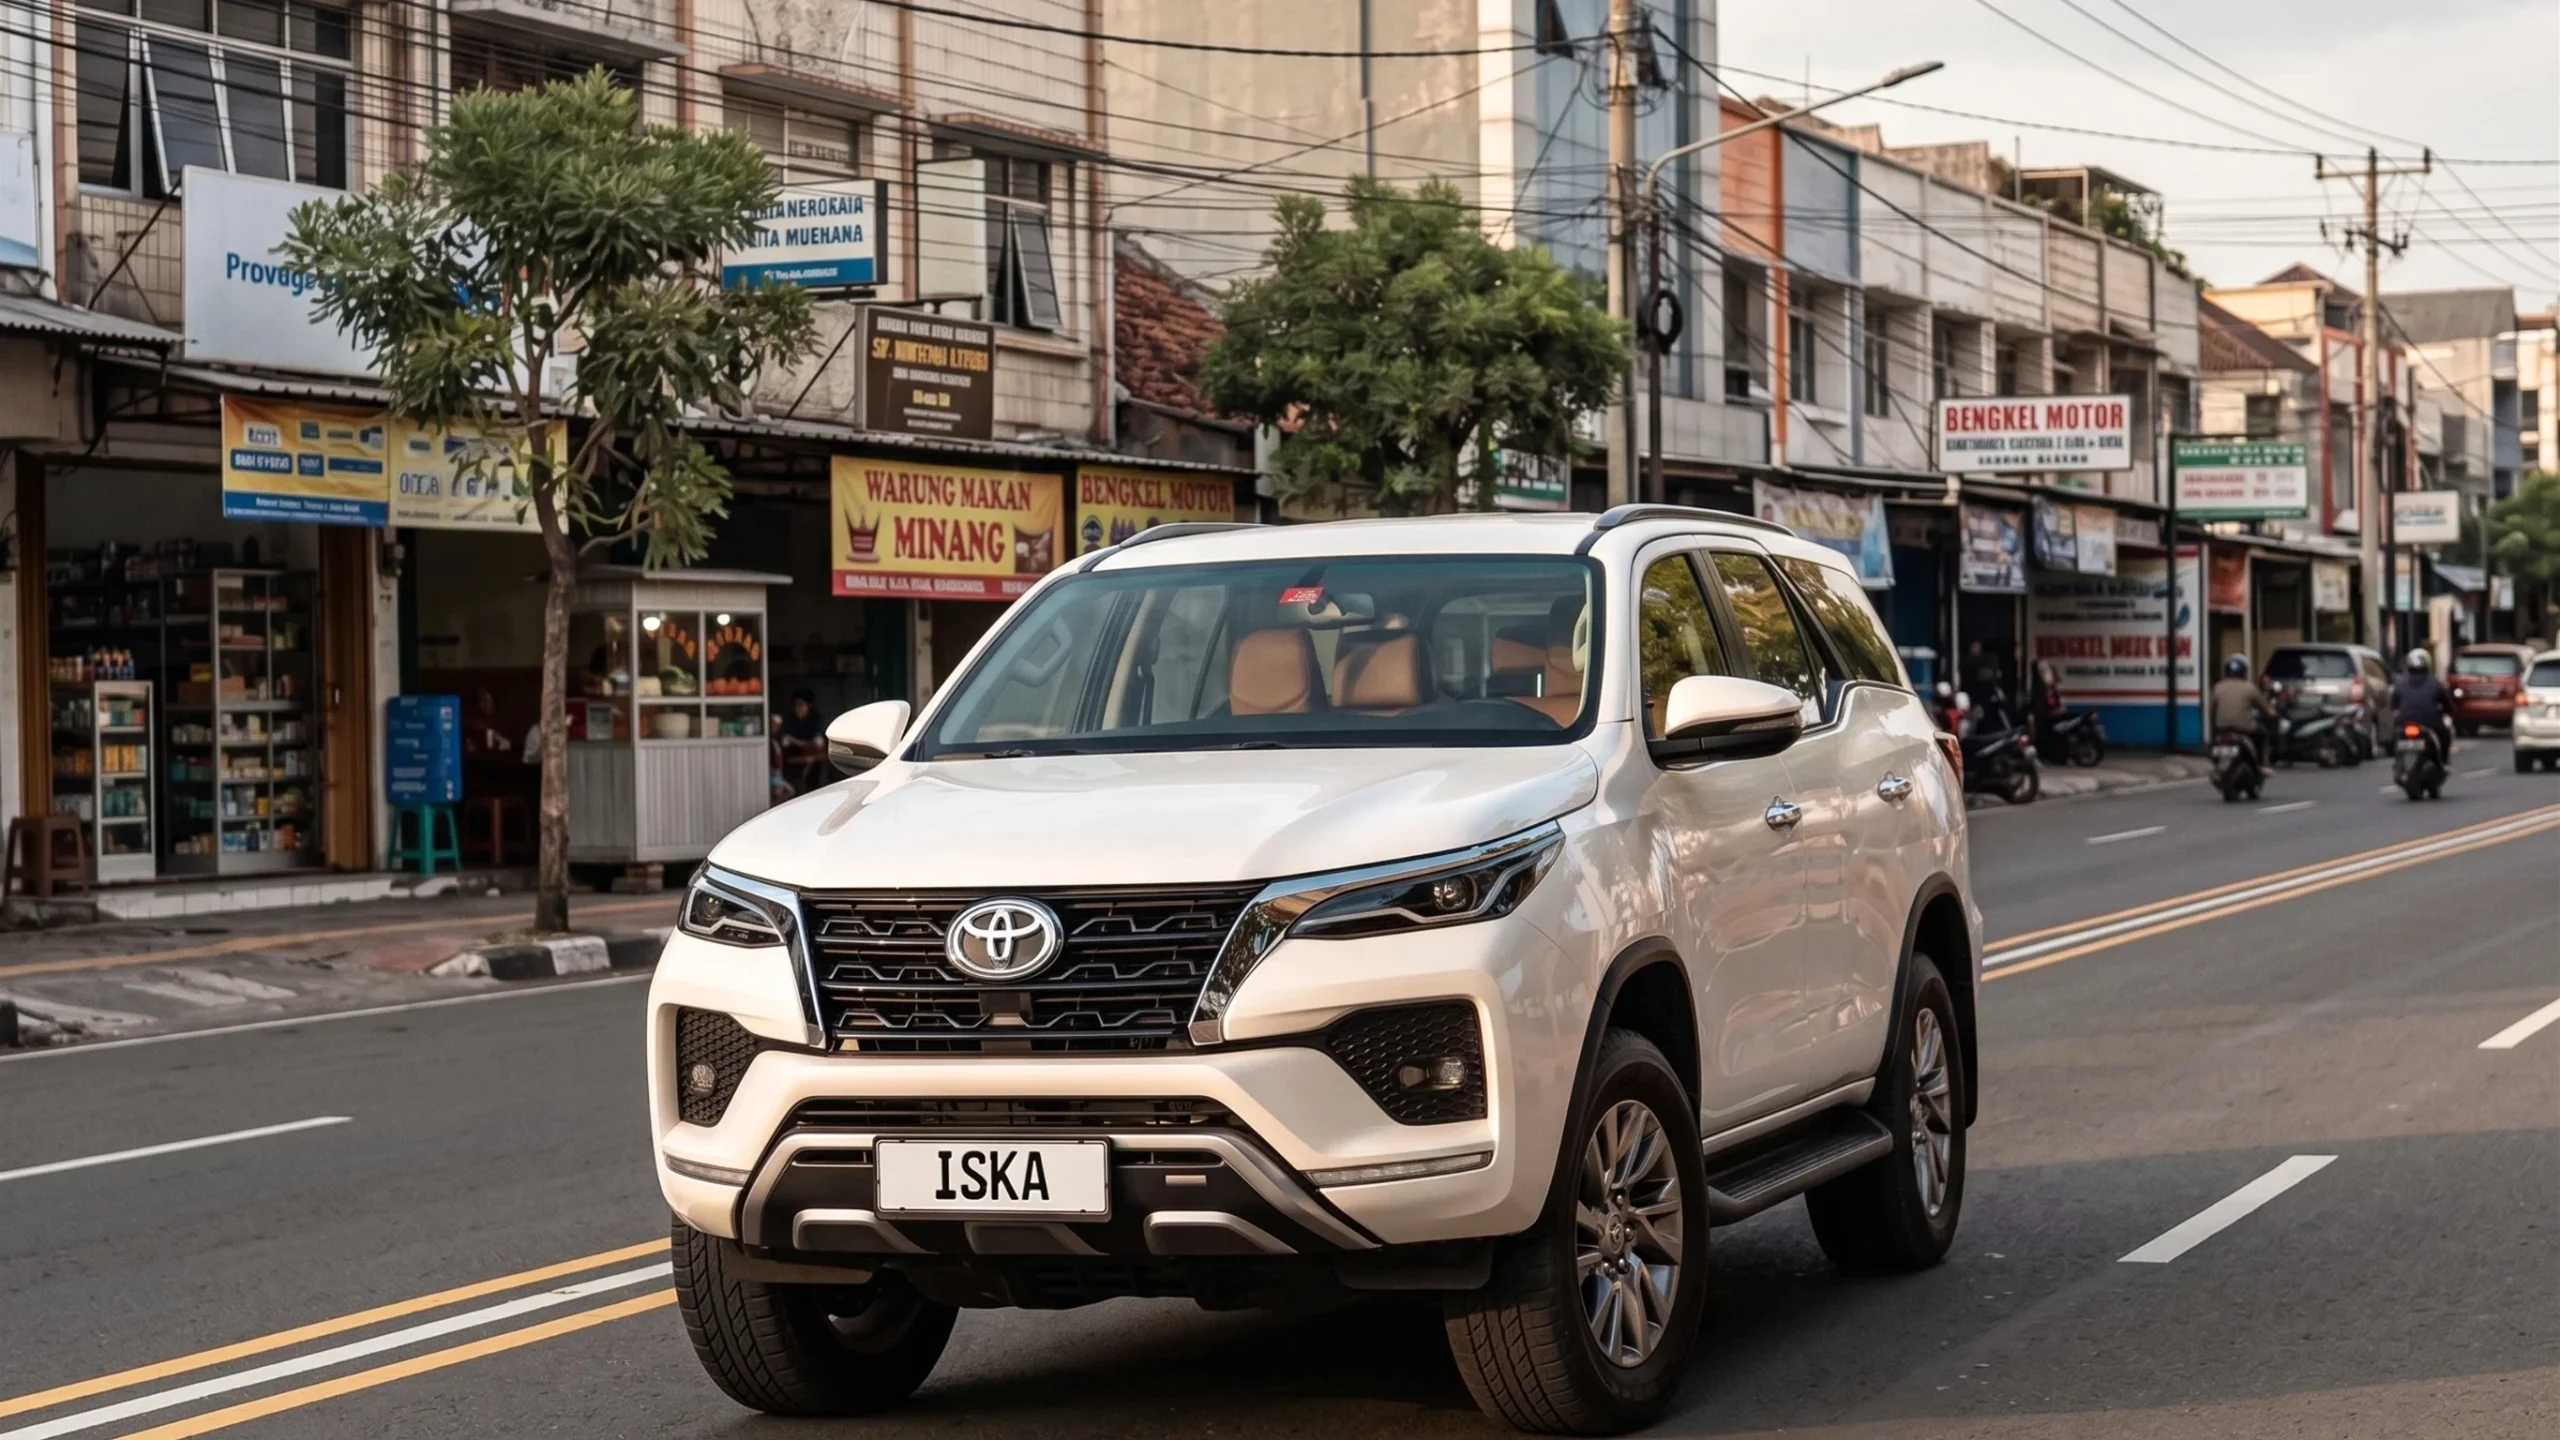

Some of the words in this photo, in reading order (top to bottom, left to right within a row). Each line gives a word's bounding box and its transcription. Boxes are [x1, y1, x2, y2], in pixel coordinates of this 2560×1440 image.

[786, 224, 864, 247] MUEHANA
[1945, 404, 2038, 432] BENGKEL
[2046, 403, 2124, 430] MOTOR
[864, 470, 956, 506] WARUNG
[960, 476, 1033, 512] MAKAN
[1080, 473, 1167, 509] BENGKEL
[1169, 480, 1232, 513] MOTOR
[893, 516, 1006, 564] MINANG
[935, 1150, 1050, 1201] ISKA
